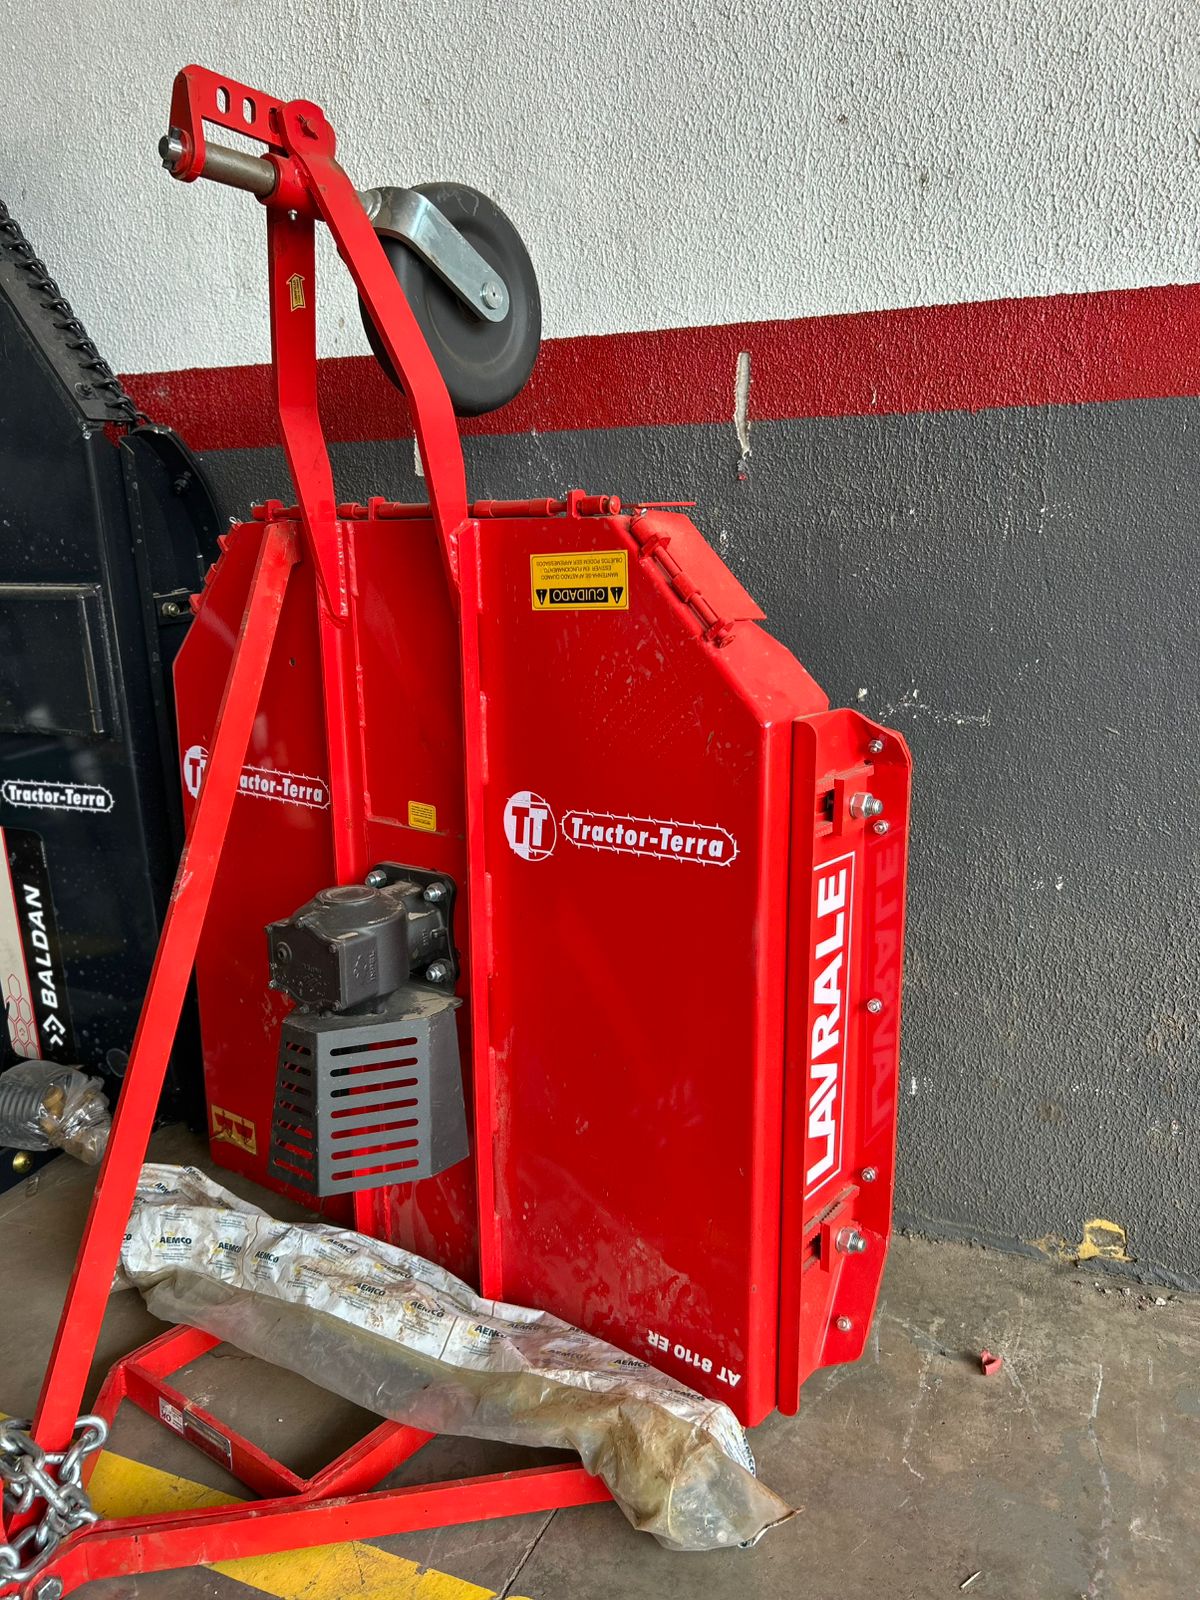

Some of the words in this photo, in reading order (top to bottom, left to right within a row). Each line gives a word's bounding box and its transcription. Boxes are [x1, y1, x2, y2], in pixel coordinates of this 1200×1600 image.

[552, 588, 605, 601] CUIDADO
[8, 785, 105, 807] Tractor-Terra
[240, 774, 323, 803] actor-Terra
[571, 817, 724, 858] Tractor-Terra
[23, 884, 58, 1009] BALDAN
[805, 868, 847, 1186] LAVRALE
[160, 1236, 192, 1245] AEMCO
[218, 1242, 242, 1253] AEMCO
[254, 1251, 279, 1263] AEMCO
[354, 1282, 386, 1297] AEMCO
[648, 1329, 669, 1352] ER
[674, 1344, 713, 1373] 8110
[716, 1366, 741, 1387] AT
